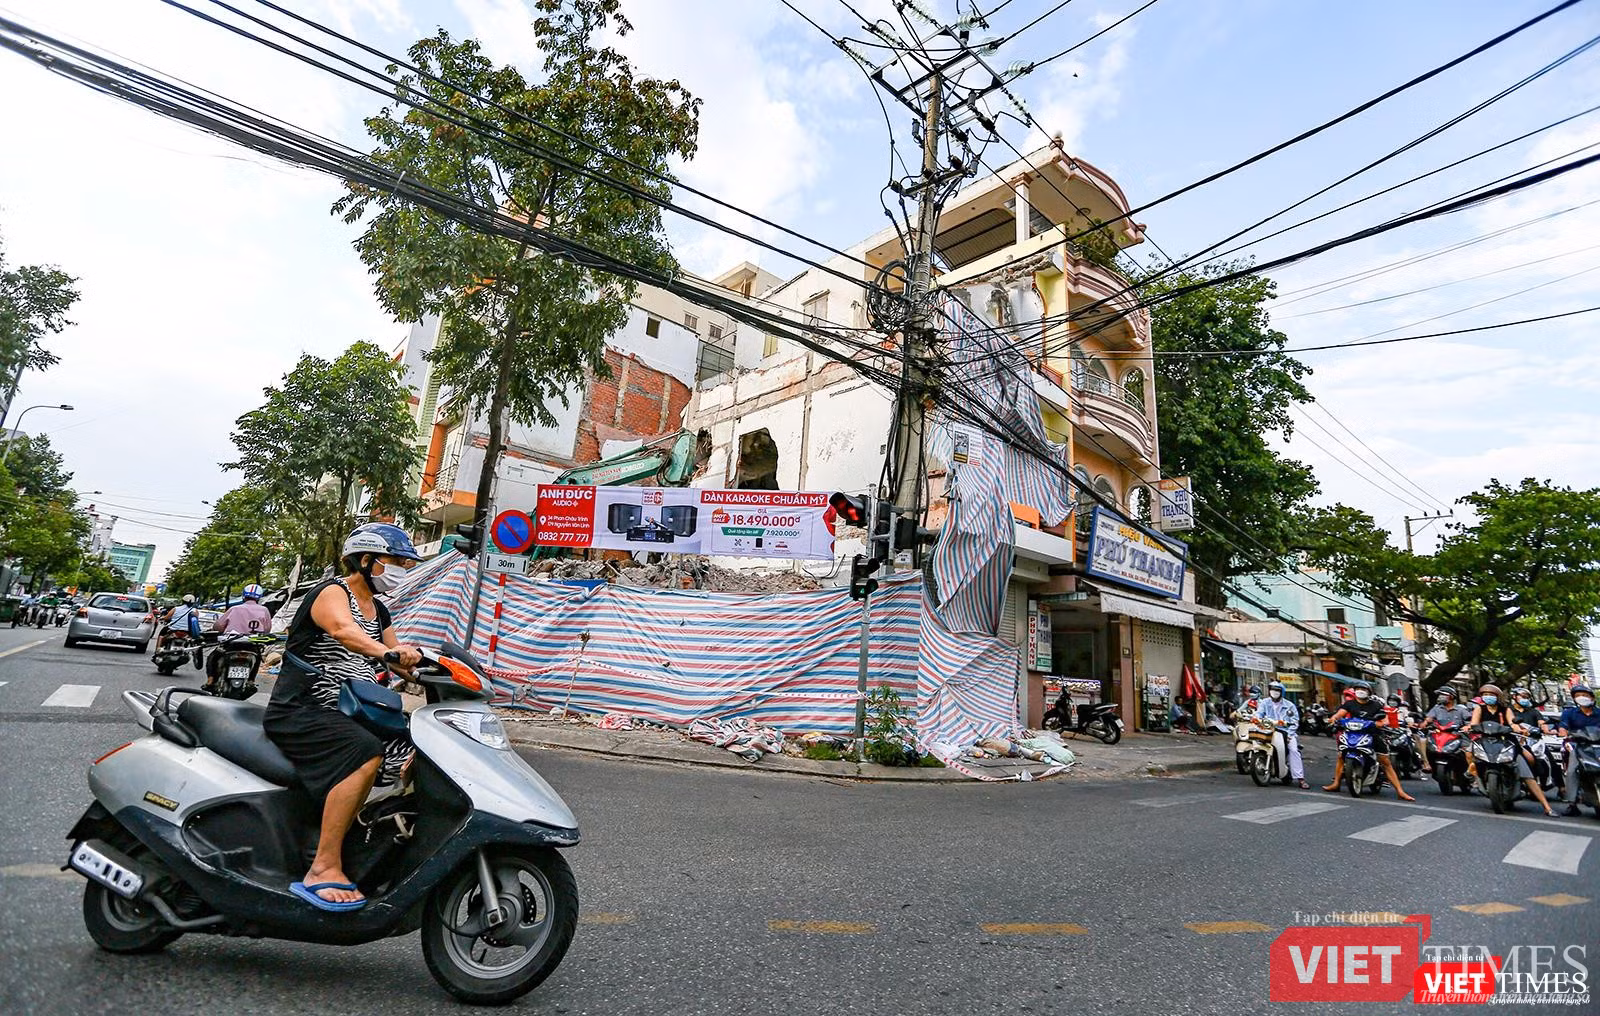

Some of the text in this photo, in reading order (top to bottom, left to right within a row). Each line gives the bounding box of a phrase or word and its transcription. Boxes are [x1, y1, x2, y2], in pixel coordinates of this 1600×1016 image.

[539, 487, 593, 500] ANH ĐỨC
[704, 490, 825, 505] DÀN KARAOKE CHUẨN MỸ
[538, 531, 589, 542] 0832 777 771
[498, 560, 515, 569] 30m
[1094, 535, 1129, 565] PHÚ
[1129, 547, 1175, 582] THẠNH
[145, 793, 177, 809] SPACY
